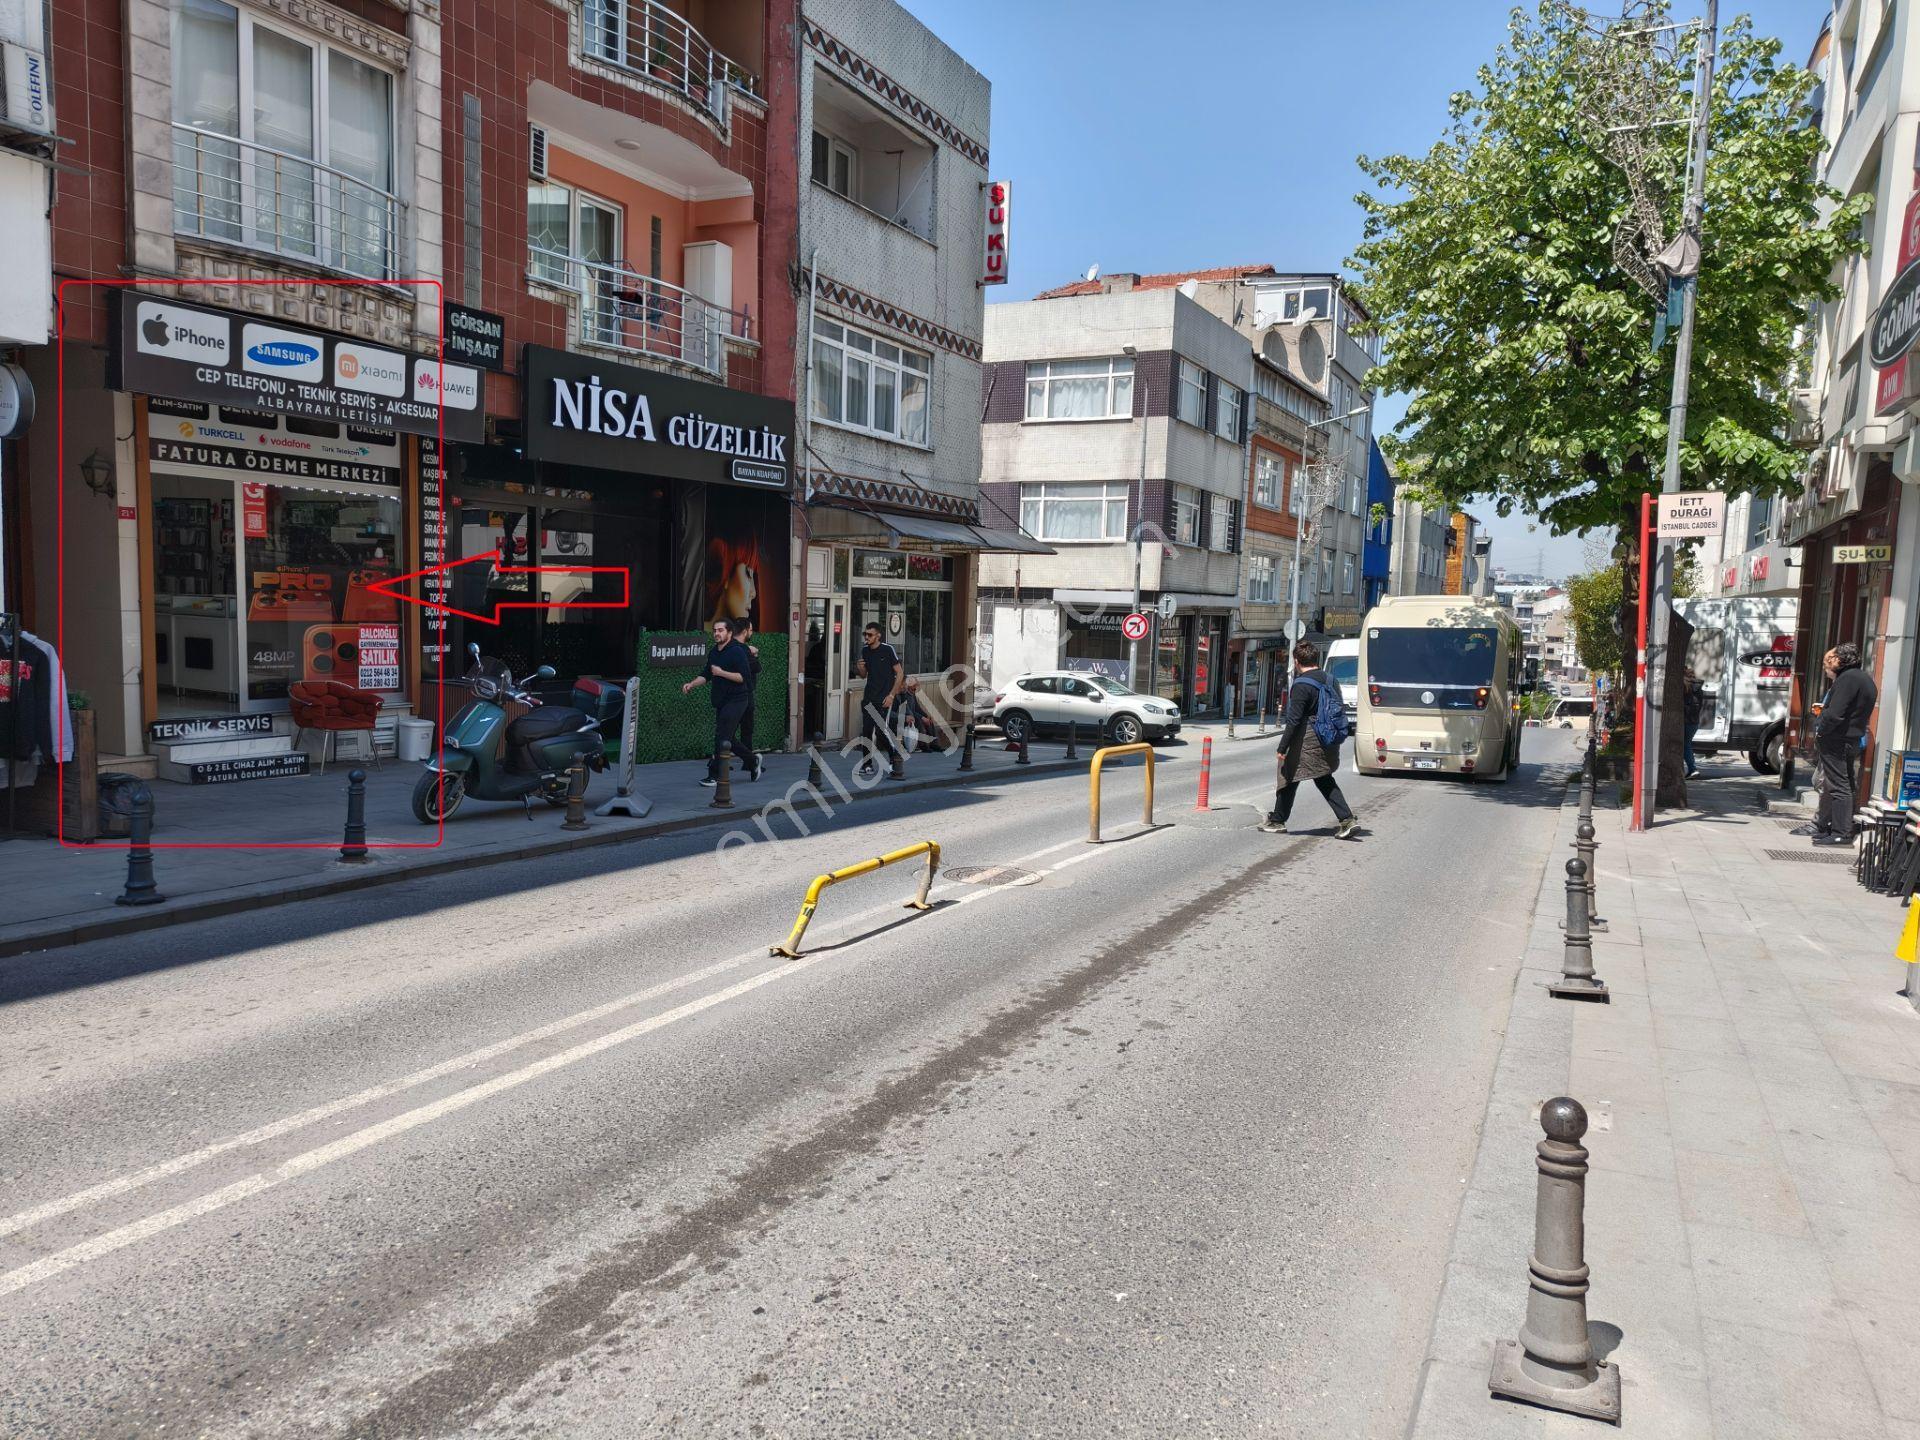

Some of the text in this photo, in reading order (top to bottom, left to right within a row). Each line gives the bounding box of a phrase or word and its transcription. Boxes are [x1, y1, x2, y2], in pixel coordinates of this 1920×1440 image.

[451, 312, 501, 338] GÖRSAN
[175, 327, 225, 350] iPhone
[452, 331, 499, 358] İNŞAAT
[257, 344, 311, 363] SAMSUNG
[1883, 371, 1898, 400] AVM
[196, 368, 221, 383] CEP
[225, 372, 286, 395] TELEFONU
[298, 384, 336, 403] TEKNİK
[340, 392, 376, 410] SERVİS
[386, 402, 439, 420] AKSESUAR
[257, 395, 393, 426] ALBAYRAK İLETİŞİM
[552, 375, 786, 462] NİSA GÜZELLİK
[198, 426, 245, 441] TURKCELL
[270, 438, 311, 450] vodafone
[157, 443, 386, 482] FATURA ÖDEME MERKEZİ
[424, 482, 439, 492] BOYA
[1680, 496, 1704, 506] İETT
[1670, 506, 1712, 518] DURAĞI
[1838, 549, 1886, 561] ŞU-KU
[253, 572, 332, 591] PRO
[1079, 615, 1124, 625] SERKAN
[360, 625, 398, 639] BALCIOĞLU
[253, 651, 295, 662] 48MP
[361, 649, 397, 665] SATILIK
[153, 715, 271, 737] TEKNİK SERVİS
[221, 763, 231, 771] EL
[258, 758, 276, 767] ALIM
[207, 773, 238, 783] FATURA
